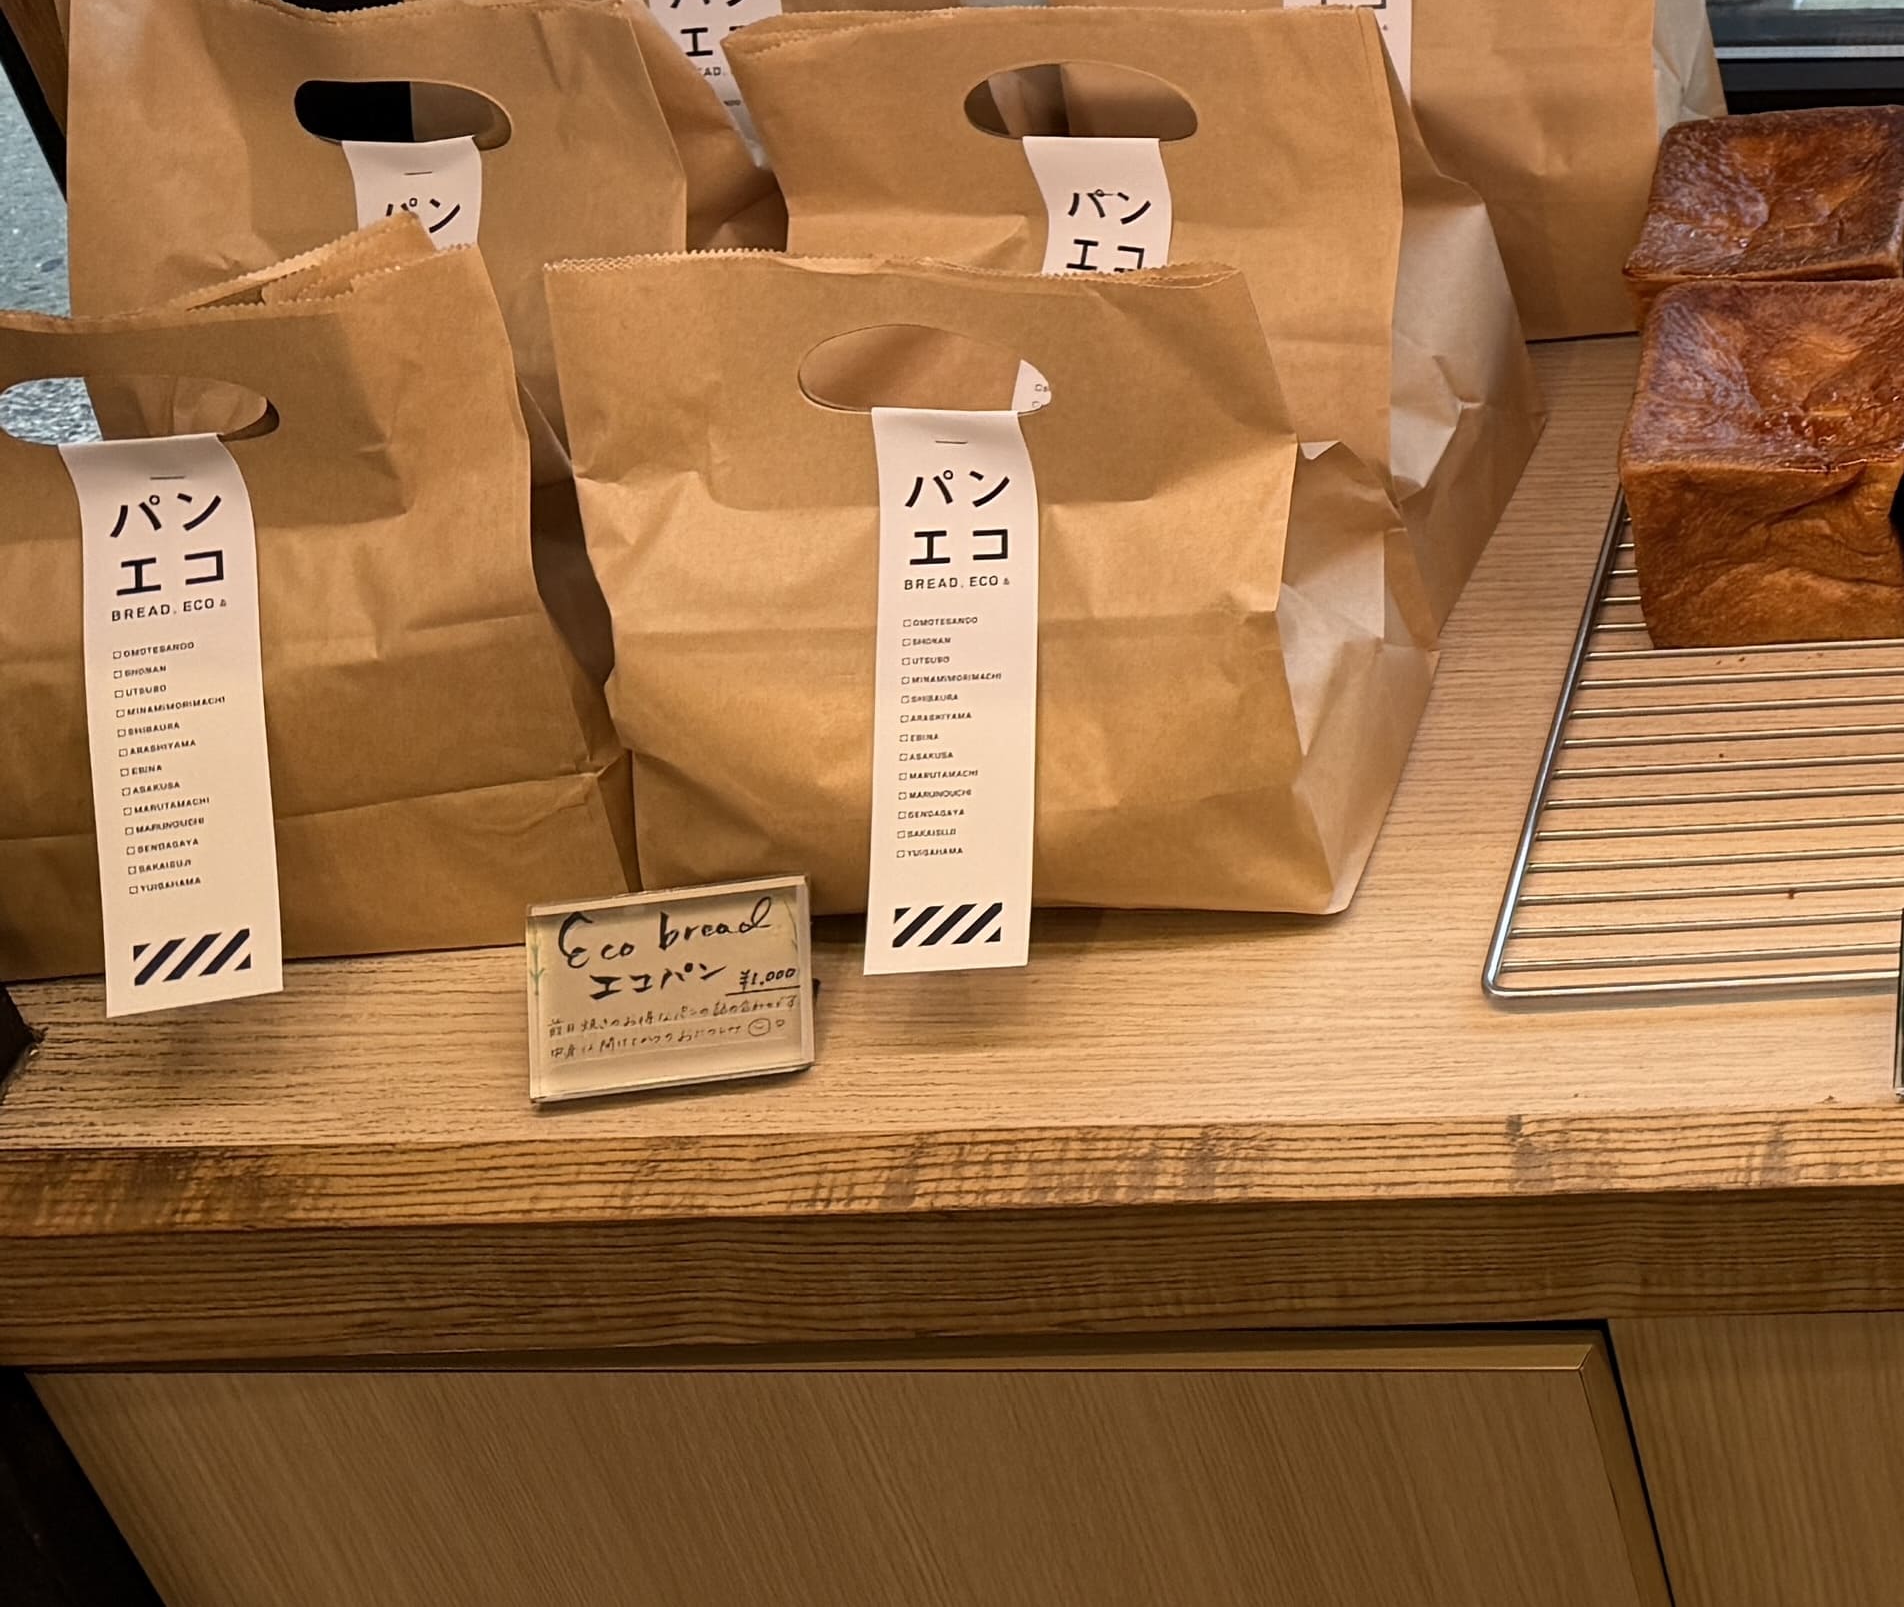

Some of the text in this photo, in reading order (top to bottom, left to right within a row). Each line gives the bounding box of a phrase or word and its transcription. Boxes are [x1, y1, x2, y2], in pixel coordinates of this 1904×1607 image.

[680, 23, 746, 58] エ
[1068, 189, 1152, 225] パン
[1066, 239, 1145, 273] エコ
[905, 469, 1010, 508] パン
[110, 493, 222, 539] パン
[909, 528, 1009, 565] エコ
[116, 550, 225, 597] エコ
[969, 575, 999, 588] ECO
[183, 597, 215, 613] ECO
[557, 896, 772, 969] Eco bread
[589, 961, 727, 1001] エコパン
